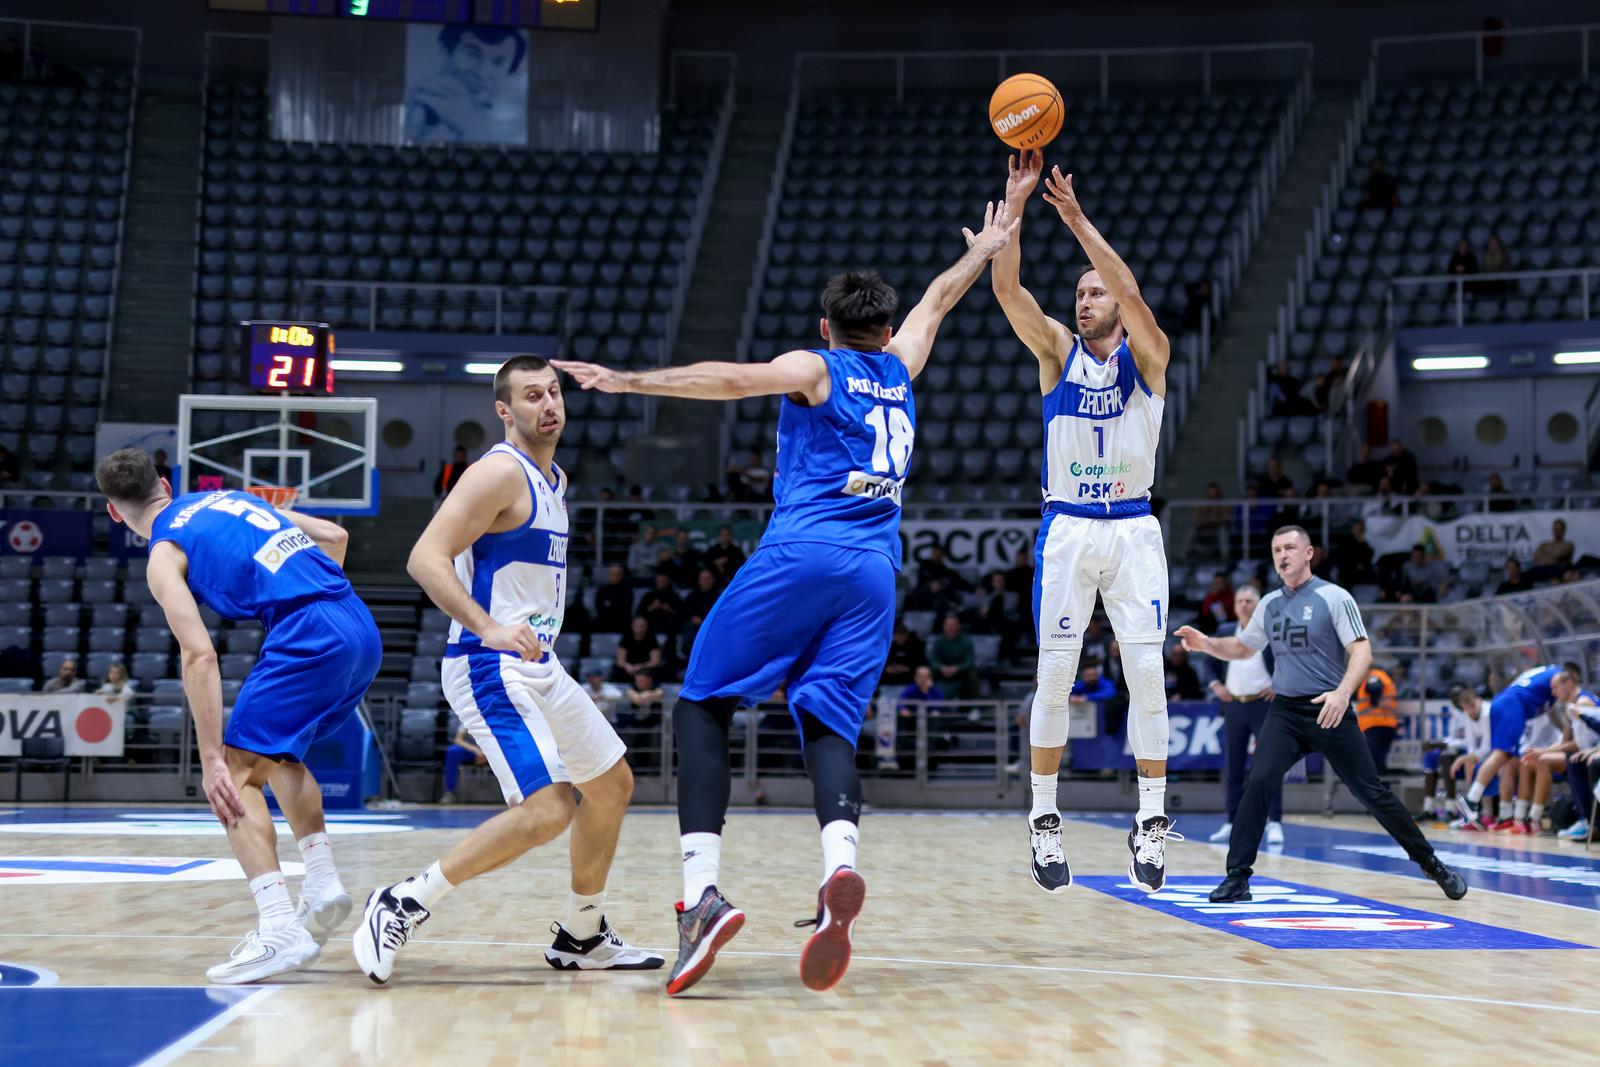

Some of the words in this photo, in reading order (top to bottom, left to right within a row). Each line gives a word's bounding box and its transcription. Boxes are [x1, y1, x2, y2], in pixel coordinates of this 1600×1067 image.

[995, 104, 1040, 134] Wilson
[268, 355, 315, 387] 21
[1078, 386, 1124, 416] ZADAR
[865, 405, 914, 478] 18
[1093, 426, 1104, 458] 1
[1078, 482, 1113, 499] PSK
[208, 498, 281, 531] 5
[1456, 524, 1531, 543] DELTA
[1151, 599, 1162, 630] 1
[0, 709, 64, 740] VA
[1122, 716, 1225, 756] SK
